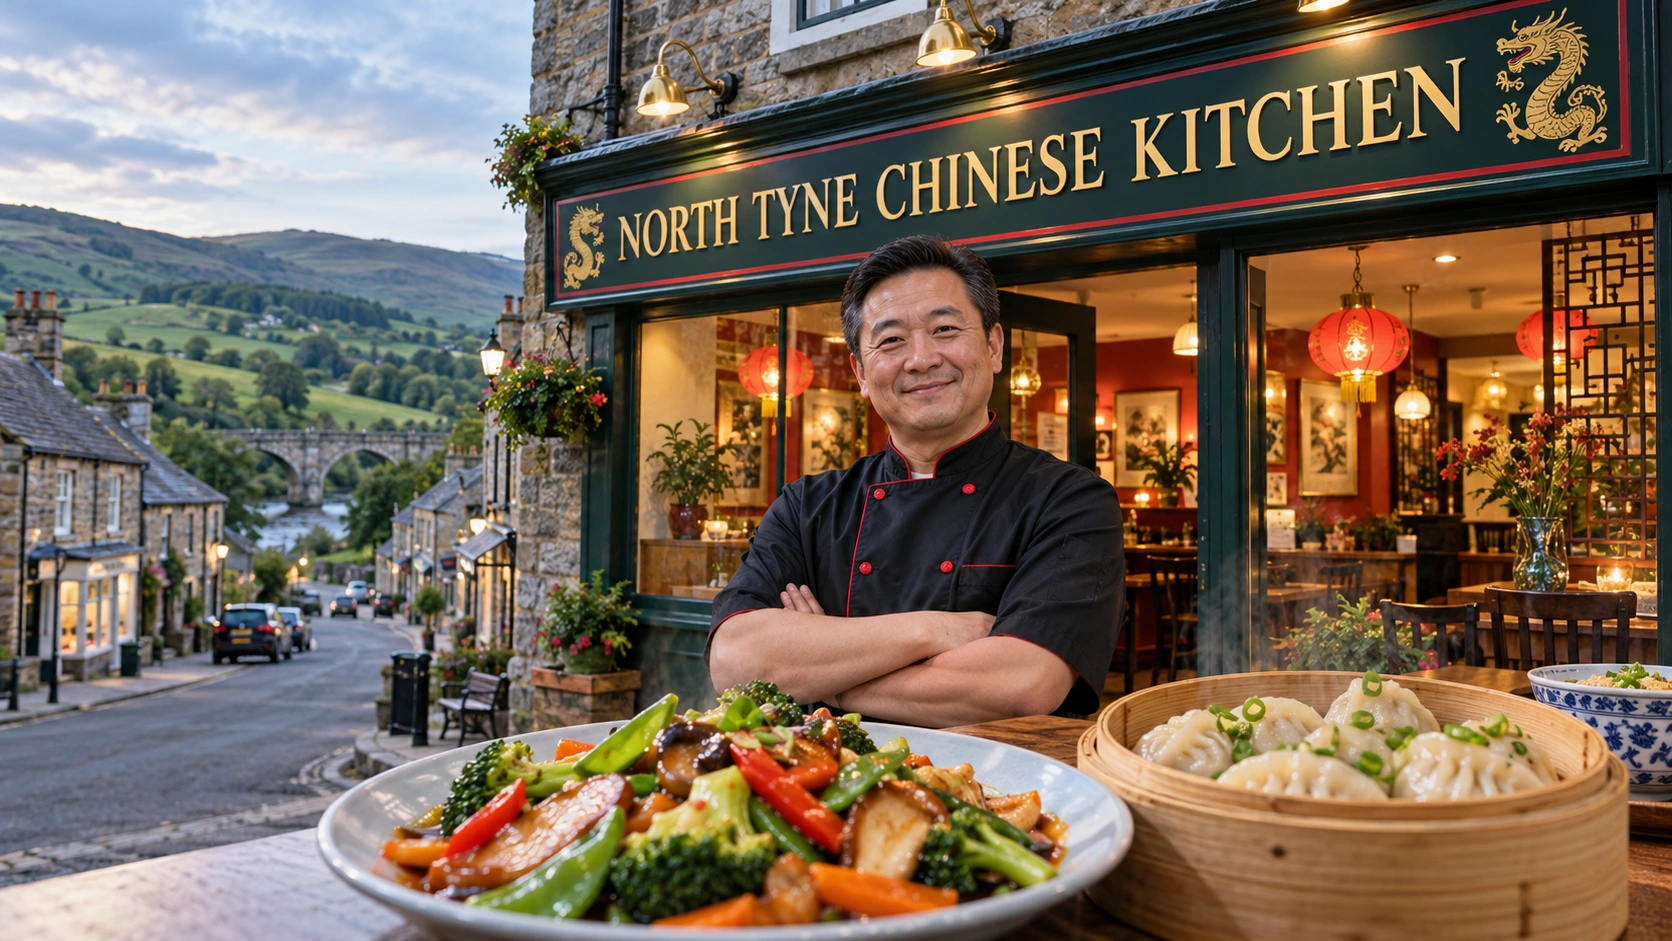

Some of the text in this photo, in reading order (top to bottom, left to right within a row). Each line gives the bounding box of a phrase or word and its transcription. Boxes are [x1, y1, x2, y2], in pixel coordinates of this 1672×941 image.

[618, 57, 1466, 261] NORTH TYNE CHINESE KITCHEN
